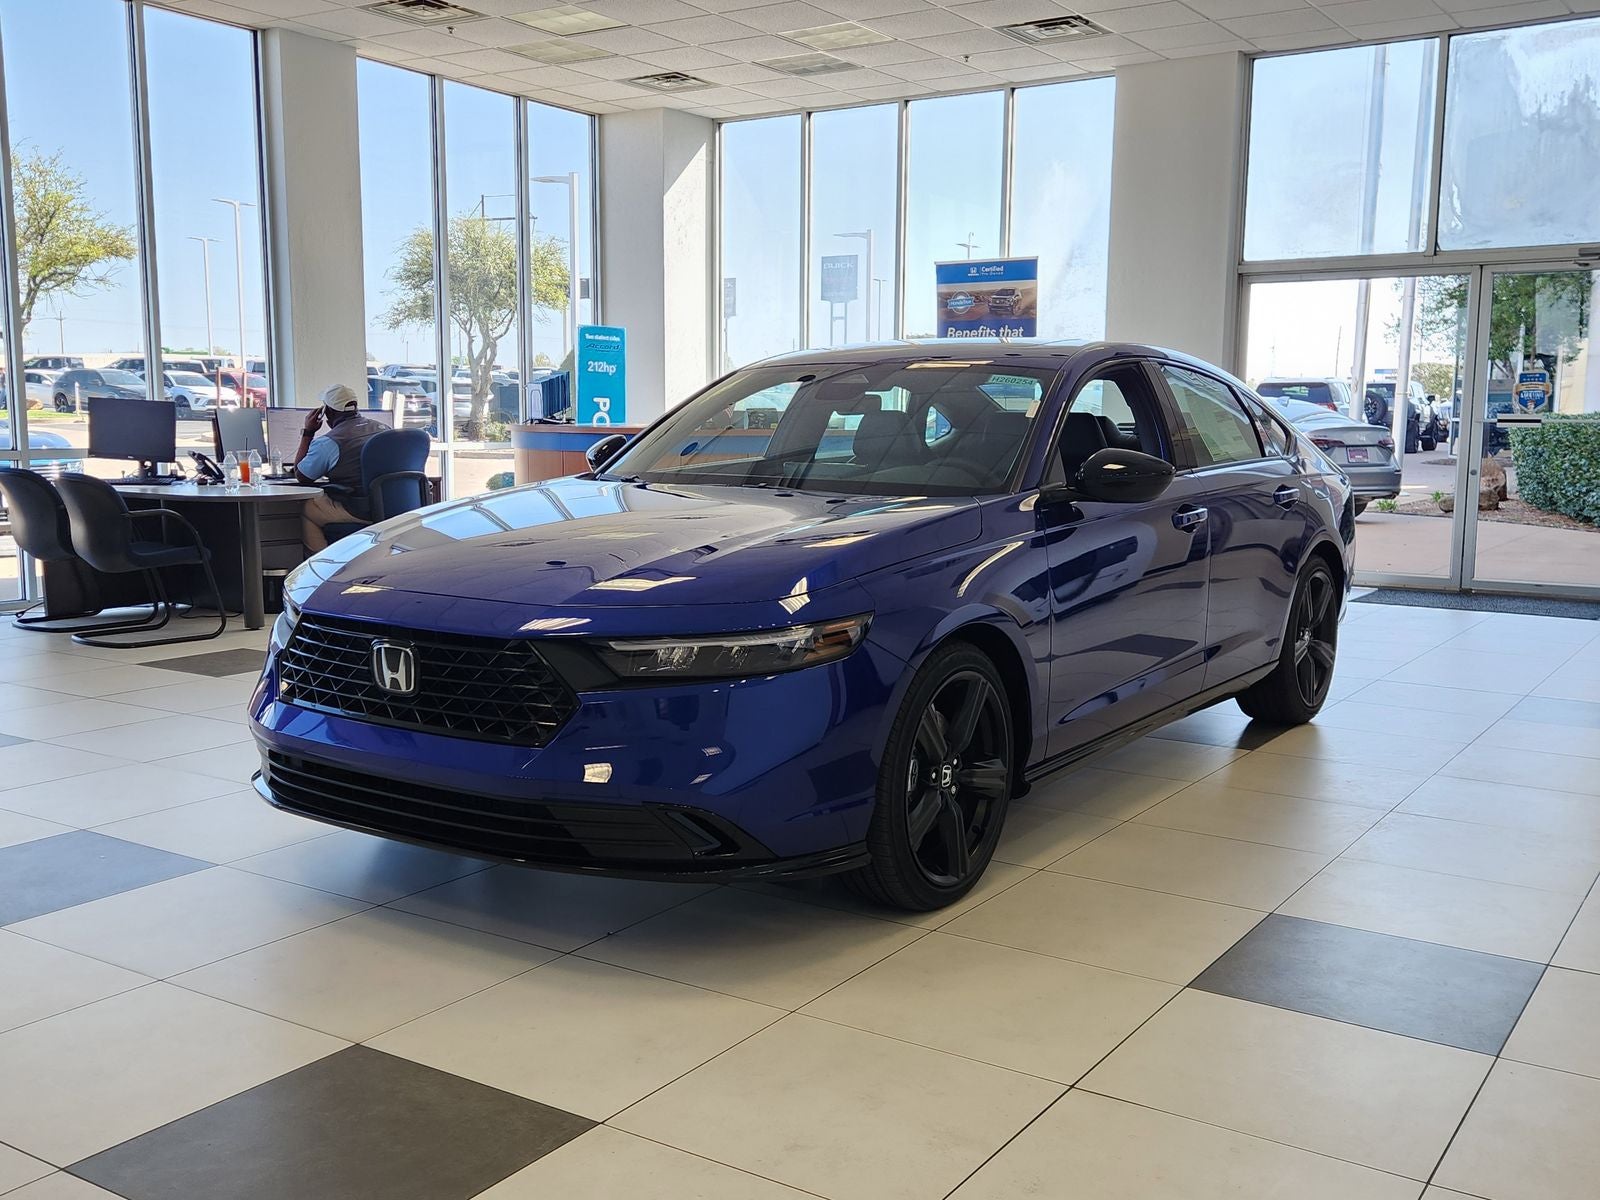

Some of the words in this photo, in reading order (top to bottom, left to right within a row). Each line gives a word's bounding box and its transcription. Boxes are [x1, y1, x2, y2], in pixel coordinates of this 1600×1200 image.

[823, 262, 855, 270] BUICK
[947, 326, 996, 338] Benefits
[999, 325, 1024, 338] that
[588, 361, 616, 375] 212hp
[992, 376, 1034, 386] H260254
